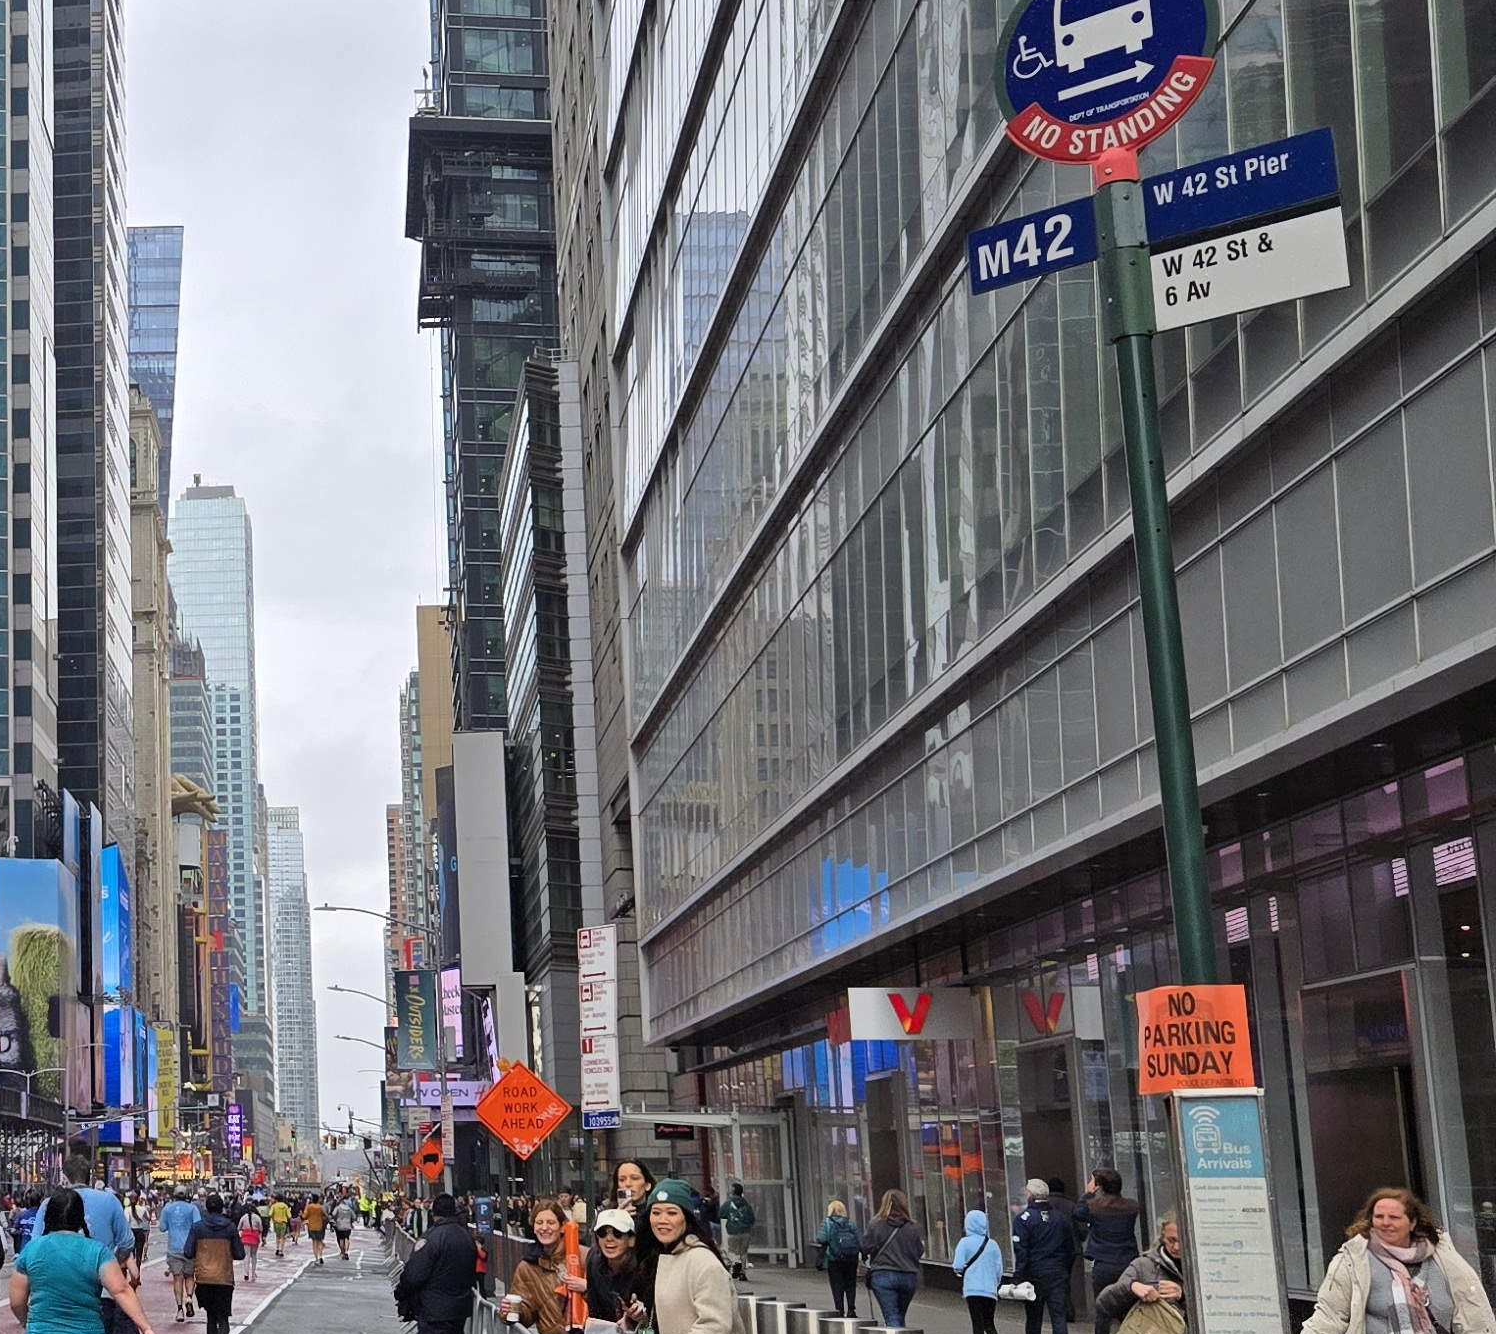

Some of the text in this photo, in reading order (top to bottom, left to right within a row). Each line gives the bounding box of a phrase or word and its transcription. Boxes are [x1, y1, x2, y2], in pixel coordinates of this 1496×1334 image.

[1021, 70, 1197, 156] NO STANDING
[1069, 91, 1149, 122] DEPT OF TRANSPORTATION
[1153, 149, 1290, 206] W 42 St Pier
[977, 213, 1076, 282] M42
[1162, 232, 1274, 278] W 42 St &
[1164, 278, 1212, 308] 6 Av
[208, 830, 227, 931] MADAME
[887, 992, 933, 1035] V
[1167, 992, 1196, 1017] NO
[213, 952, 229, 1092] TUSSAUDS
[1144, 1020, 1236, 1049] PARKING
[584, 1039, 590, 1053] 1
[1147, 1051, 1233, 1078] SUNDAY
[502, 1086, 538, 1098] ROAD
[1176, 1078, 1245, 1087] POLICE DEPARTMENT
[503, 1102, 538, 1114] WORK
[588, 1117, 611, 1127] 103955
[501, 1118, 544, 1130] AHEAD
[1222, 1142, 1251, 1154] Bus
[1196, 1157, 1252, 1170] Arrivals
